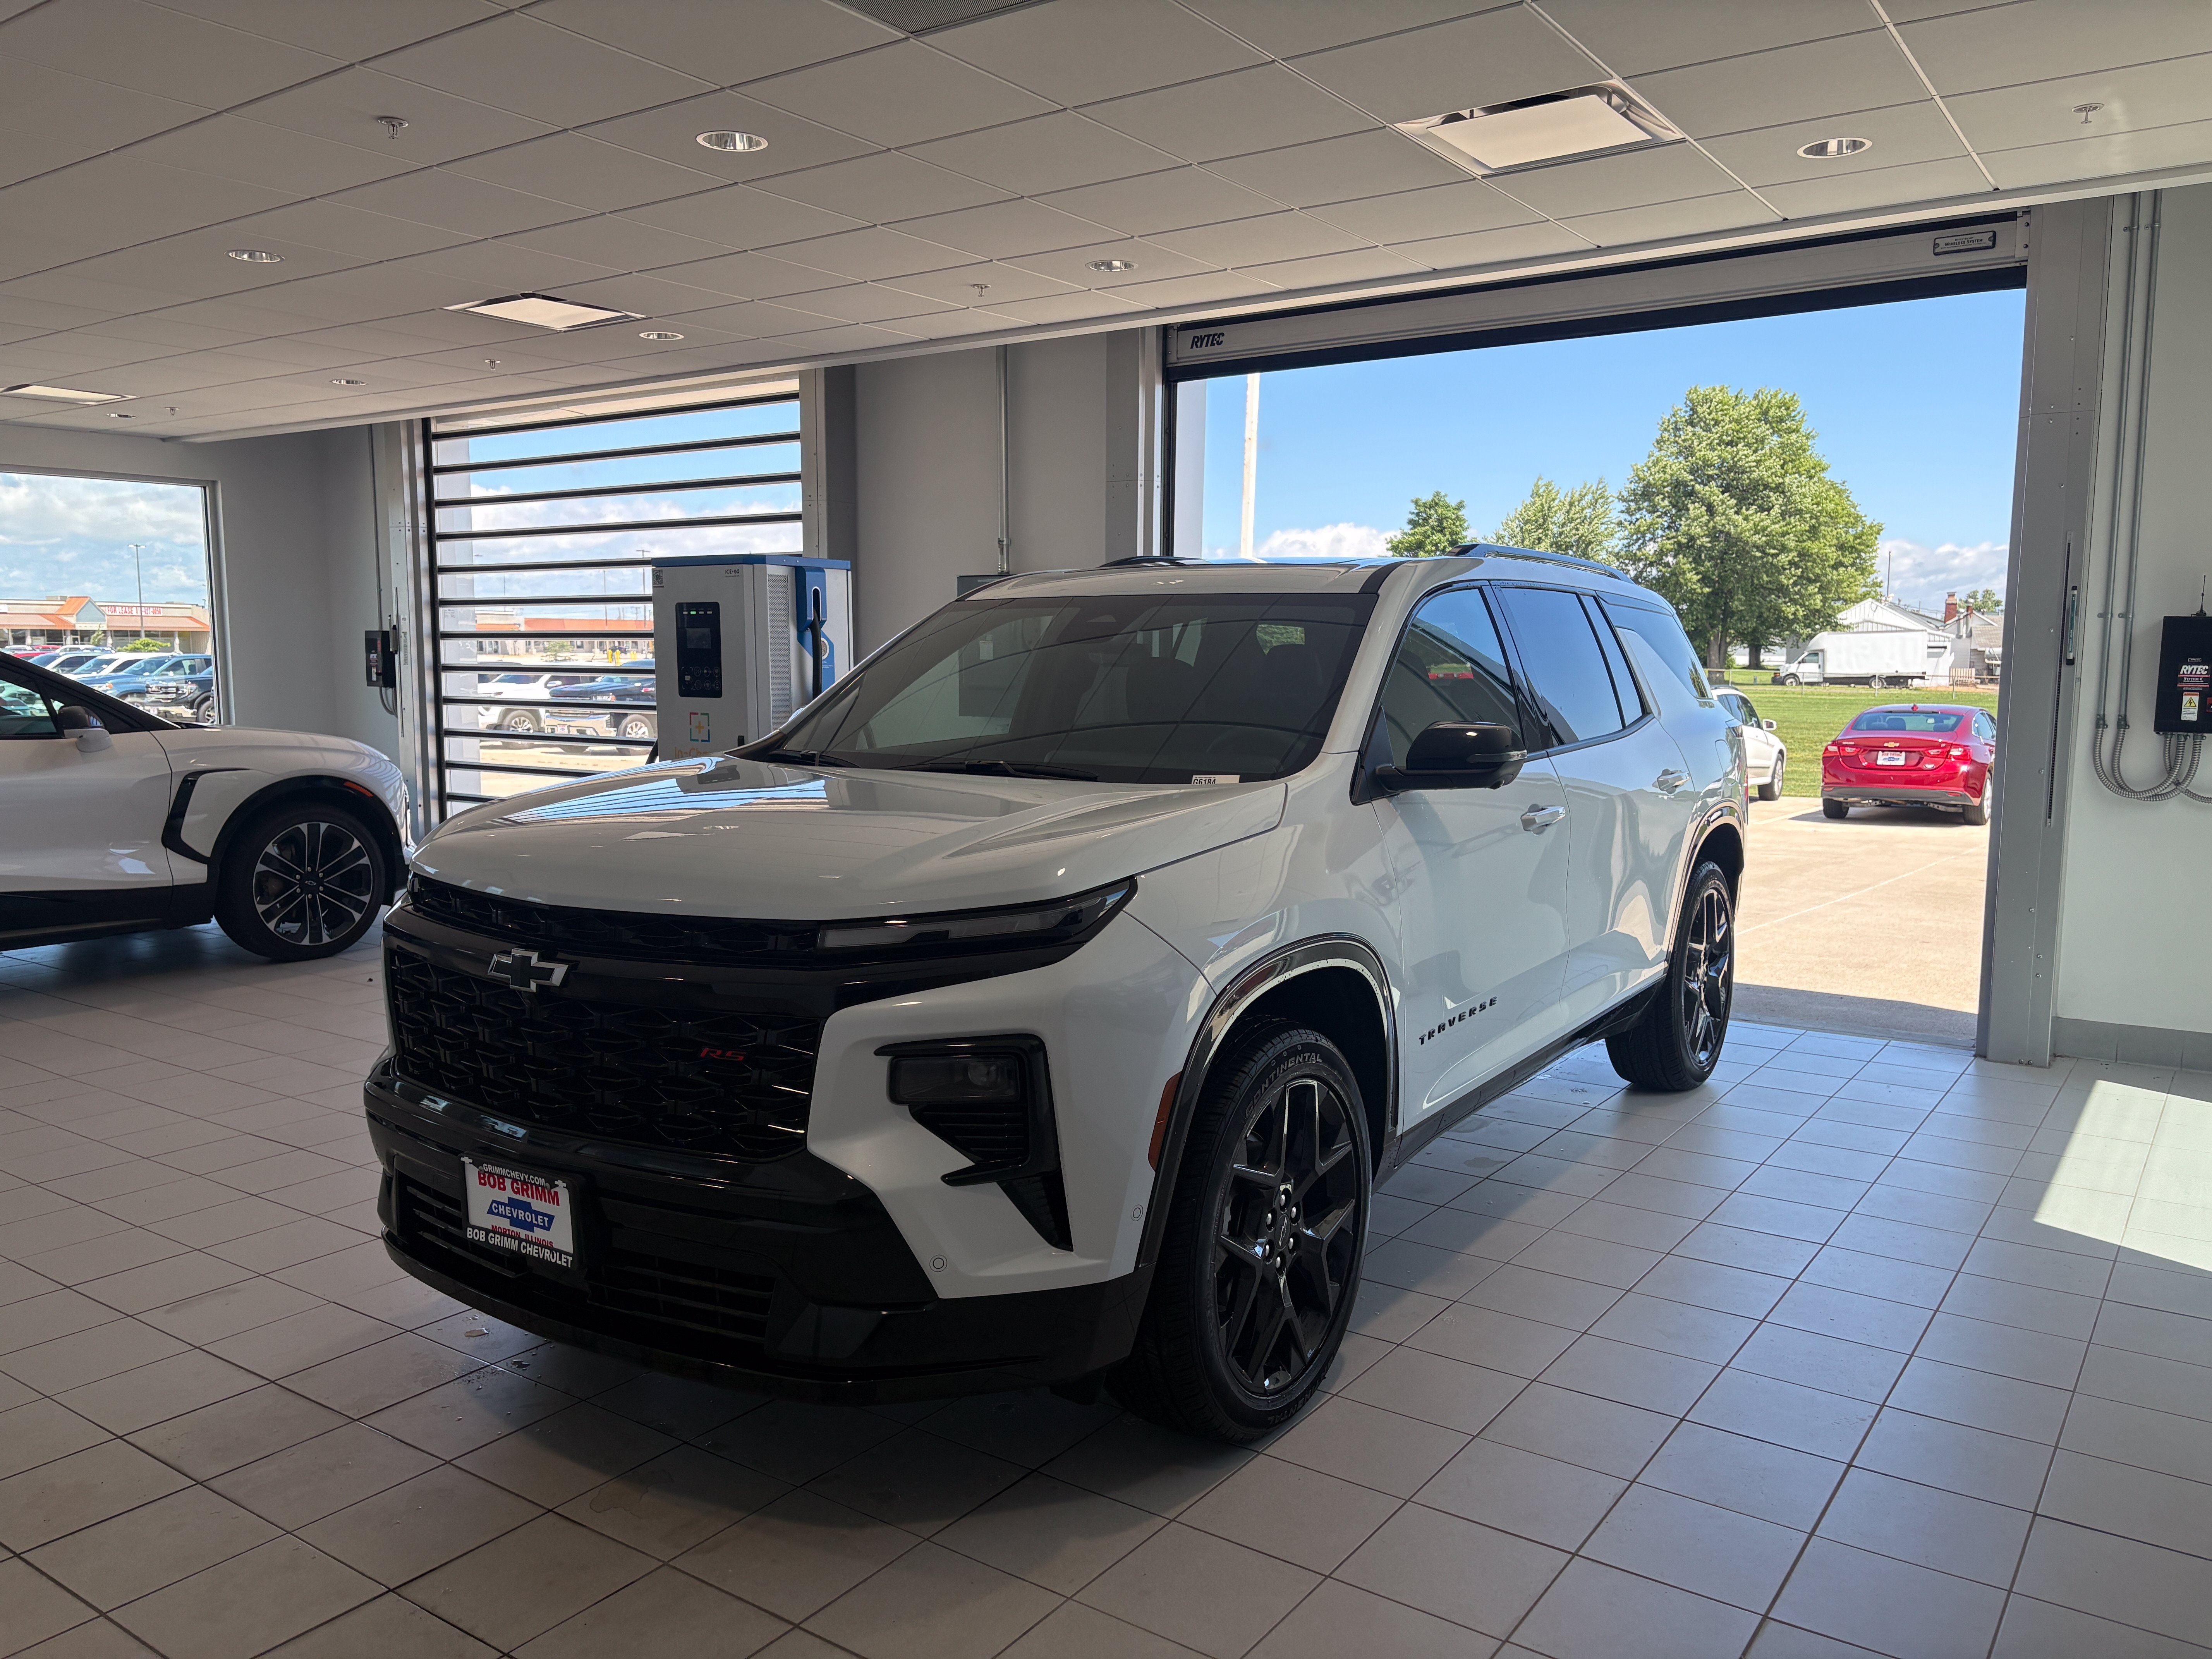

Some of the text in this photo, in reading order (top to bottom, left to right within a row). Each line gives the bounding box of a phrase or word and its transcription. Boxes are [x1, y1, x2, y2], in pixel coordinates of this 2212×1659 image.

[1190, 332, 1224, 349] RYTEC
[2180, 665, 2209, 675] RYTEC
[1419, 996, 1497, 1045] TRAVERSE
[700, 1048, 747, 1061] RS
[1245, 1053, 1323, 1118] CONTINENTAL
[483, 1163, 545, 1186] GRIMMCHEVY.COM
[478, 1170, 560, 1207] BOB GRIMM
[492, 1203, 549, 1227] CHEVROLET
[467, 1227, 573, 1268] BOB GRIMM CHEVROLET
[491, 1224, 554, 1248] MORTON ILLINOIS
